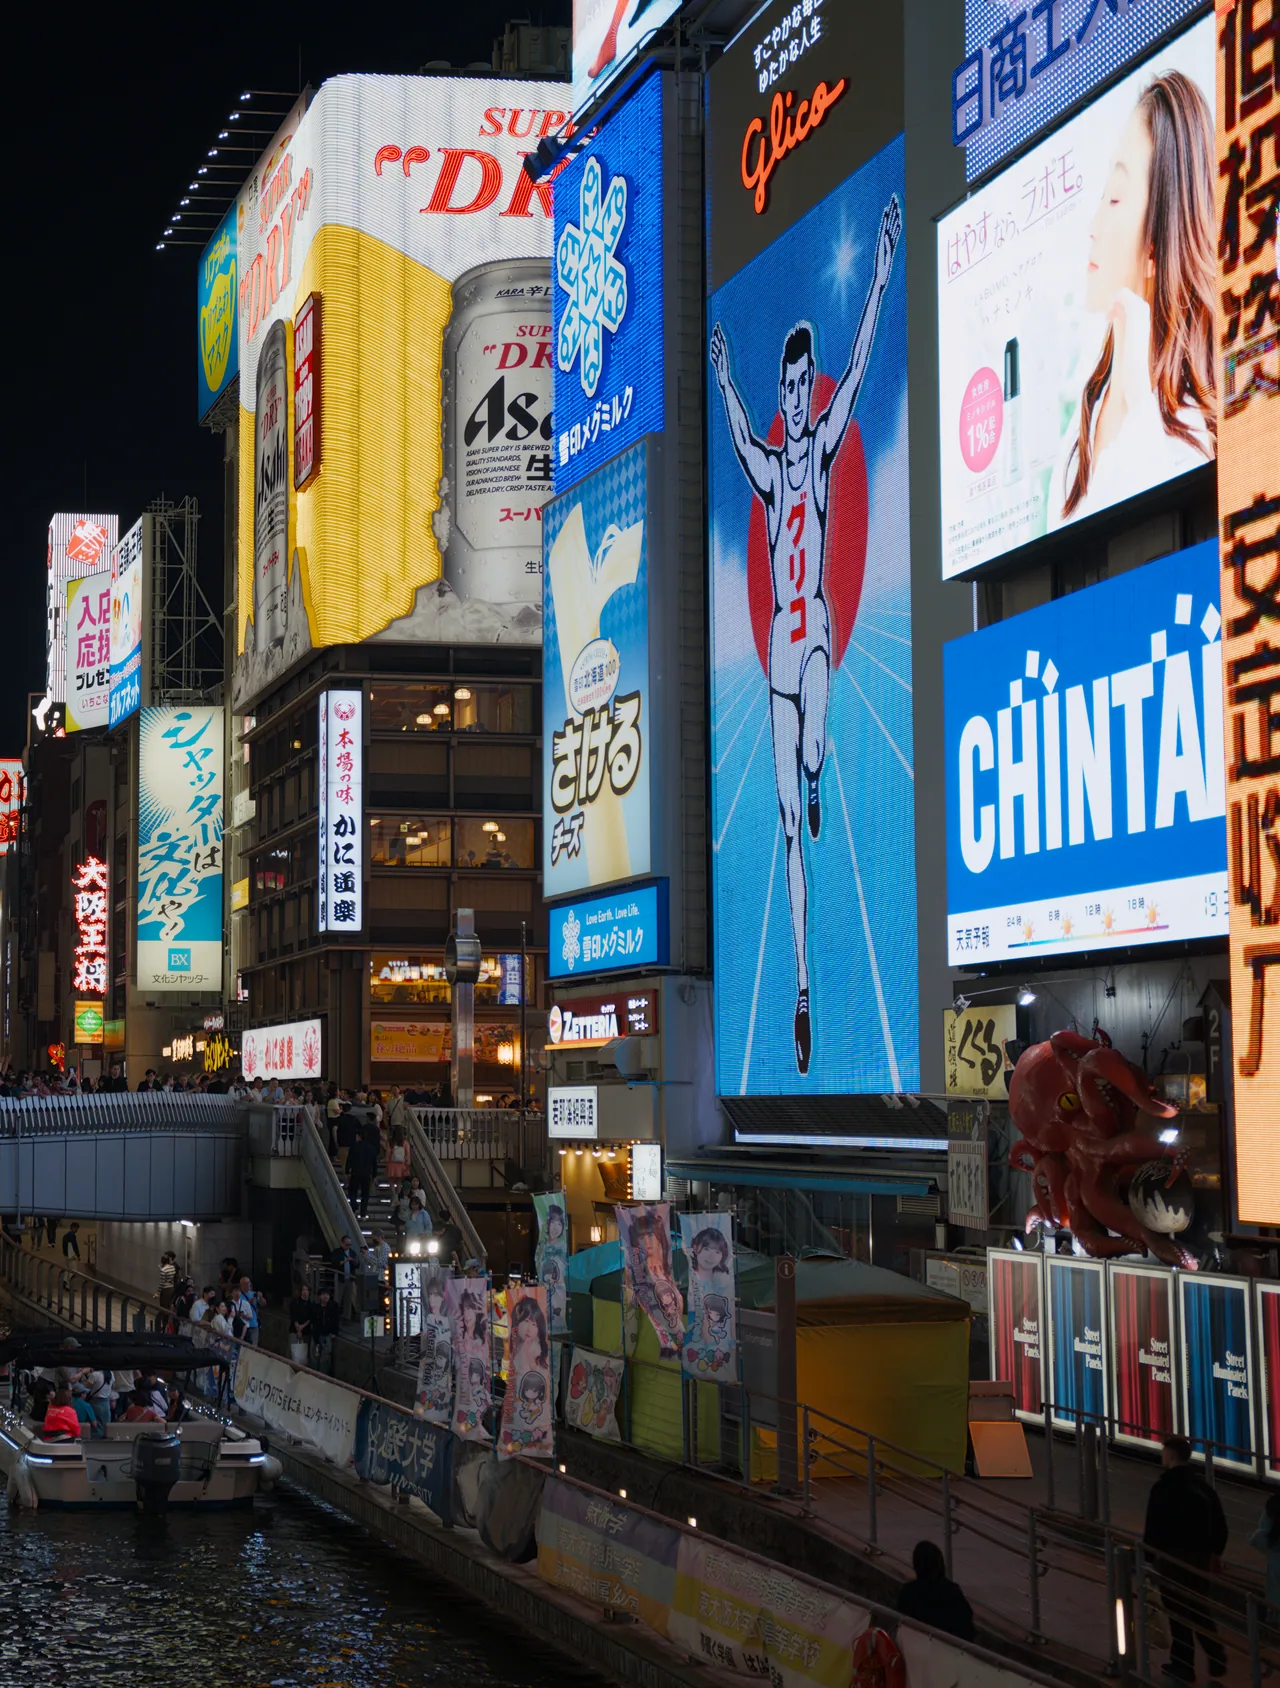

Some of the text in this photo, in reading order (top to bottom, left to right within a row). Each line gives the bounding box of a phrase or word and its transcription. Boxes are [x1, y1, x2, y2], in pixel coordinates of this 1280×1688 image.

[758, 16, 821, 93] ゆたかな人生
[742, 78, 845, 214] Glico
[496, 288, 524, 297] KARA
[559, 386, 632, 466] 雪印メグミルク
[967, 420, 989, 457] 1%
[481, 446, 500, 454] SUPER
[488, 465, 521, 473] JAPANESE
[786, 493, 807, 643] グリコ
[551, 690, 641, 815] さける
[333, 727, 356, 922] 本場の味 かに道楽
[552, 811, 584, 866] チーズ
[72, 856, 110, 993] 大阪王将
[586, 903, 640, 925] Love Earth. Love Life.
[583, 926, 644, 962] 雪印メグミルク
[956, 926, 990, 950] 天気予報
[170, 952, 188, 966] BX
[563, 1012, 618, 1040] ZETTERIA
[1150, 1336, 1168, 1354] Street
[1225, 1350, 1245, 1369] Street
